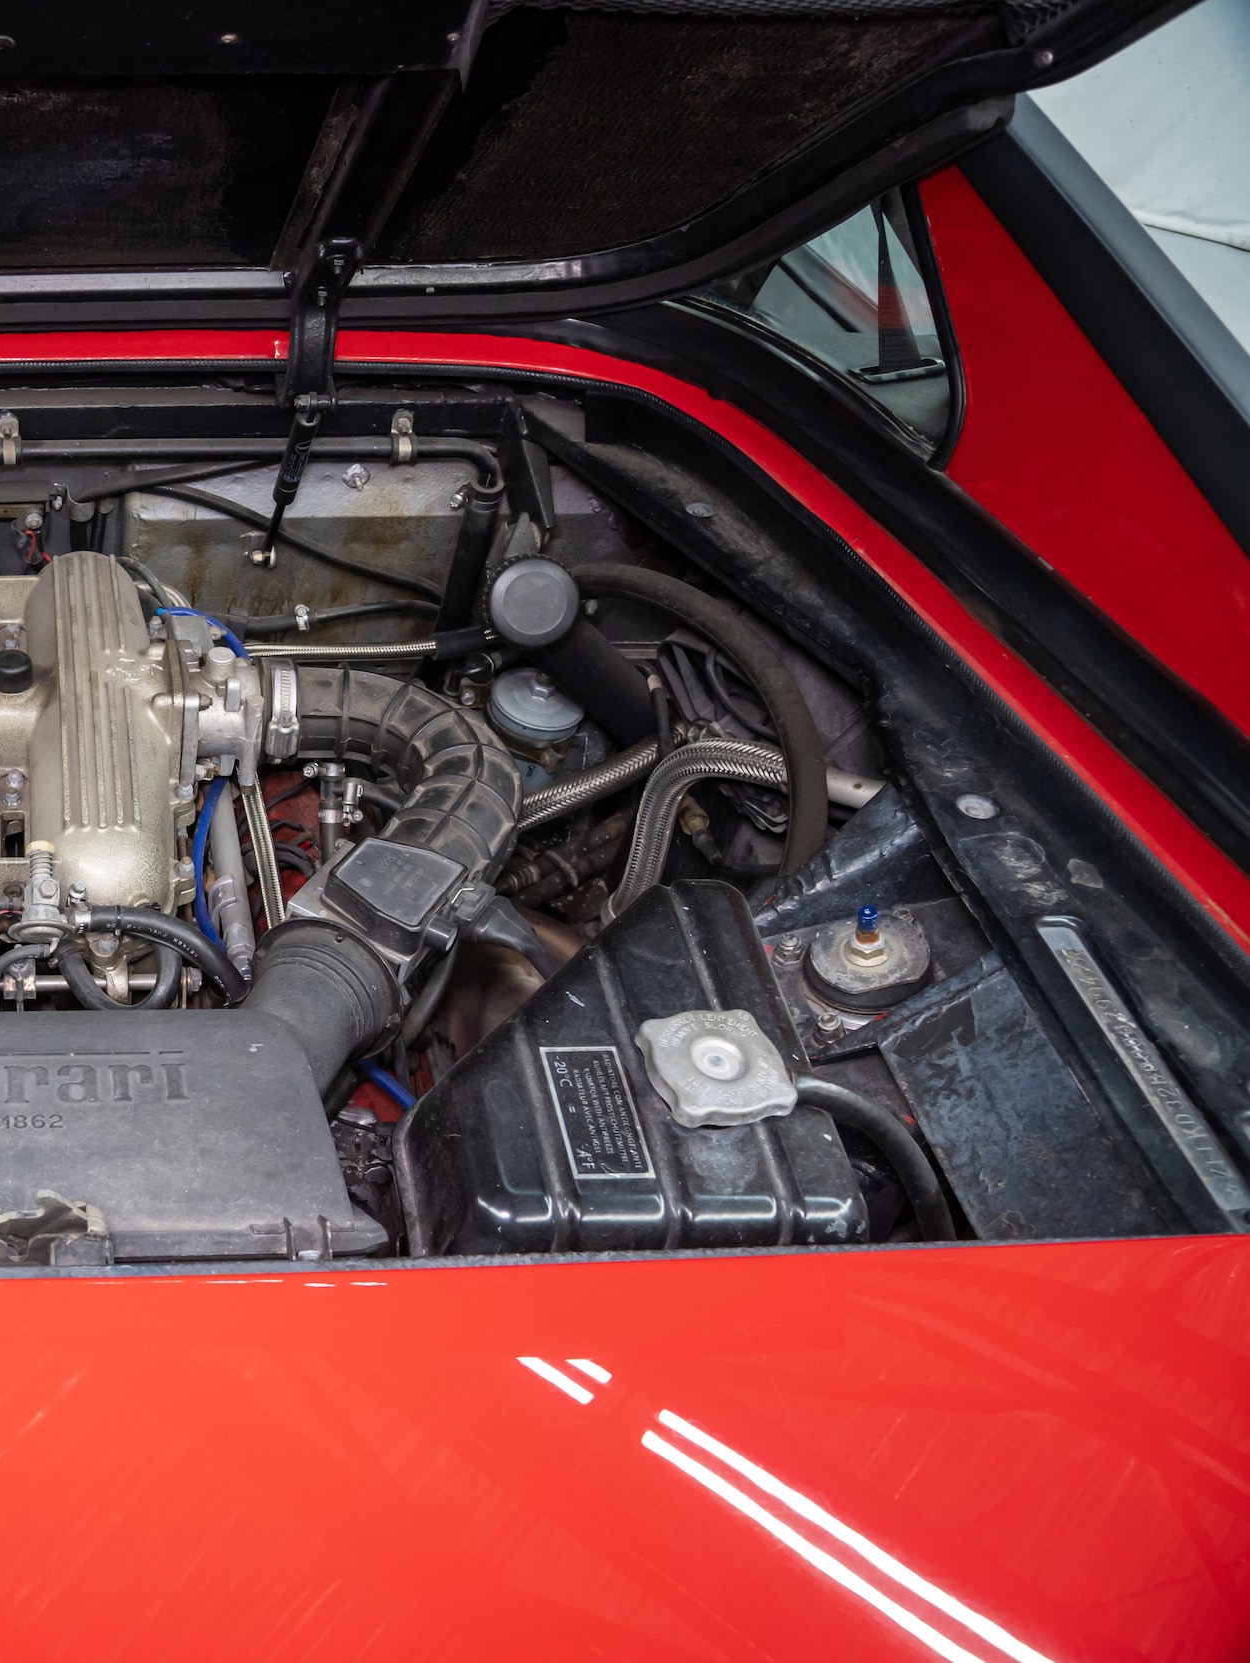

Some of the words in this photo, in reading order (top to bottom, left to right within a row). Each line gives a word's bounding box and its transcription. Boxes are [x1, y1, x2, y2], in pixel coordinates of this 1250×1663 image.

[670, 1022, 699, 1048] REMOVE
[572, 1069, 587, 1103] RADIATEUR
[582, 1067, 597, 1097] RADIATOR
[592, 1099, 602, 1116] WITH
[601, 1054, 618, 1088] RADIATORE
[612, 1090, 623, 1104] CON
[582, 1105, 593, 1122] AVEC
[587, 1124, 602, 1153] ANTIGEL
